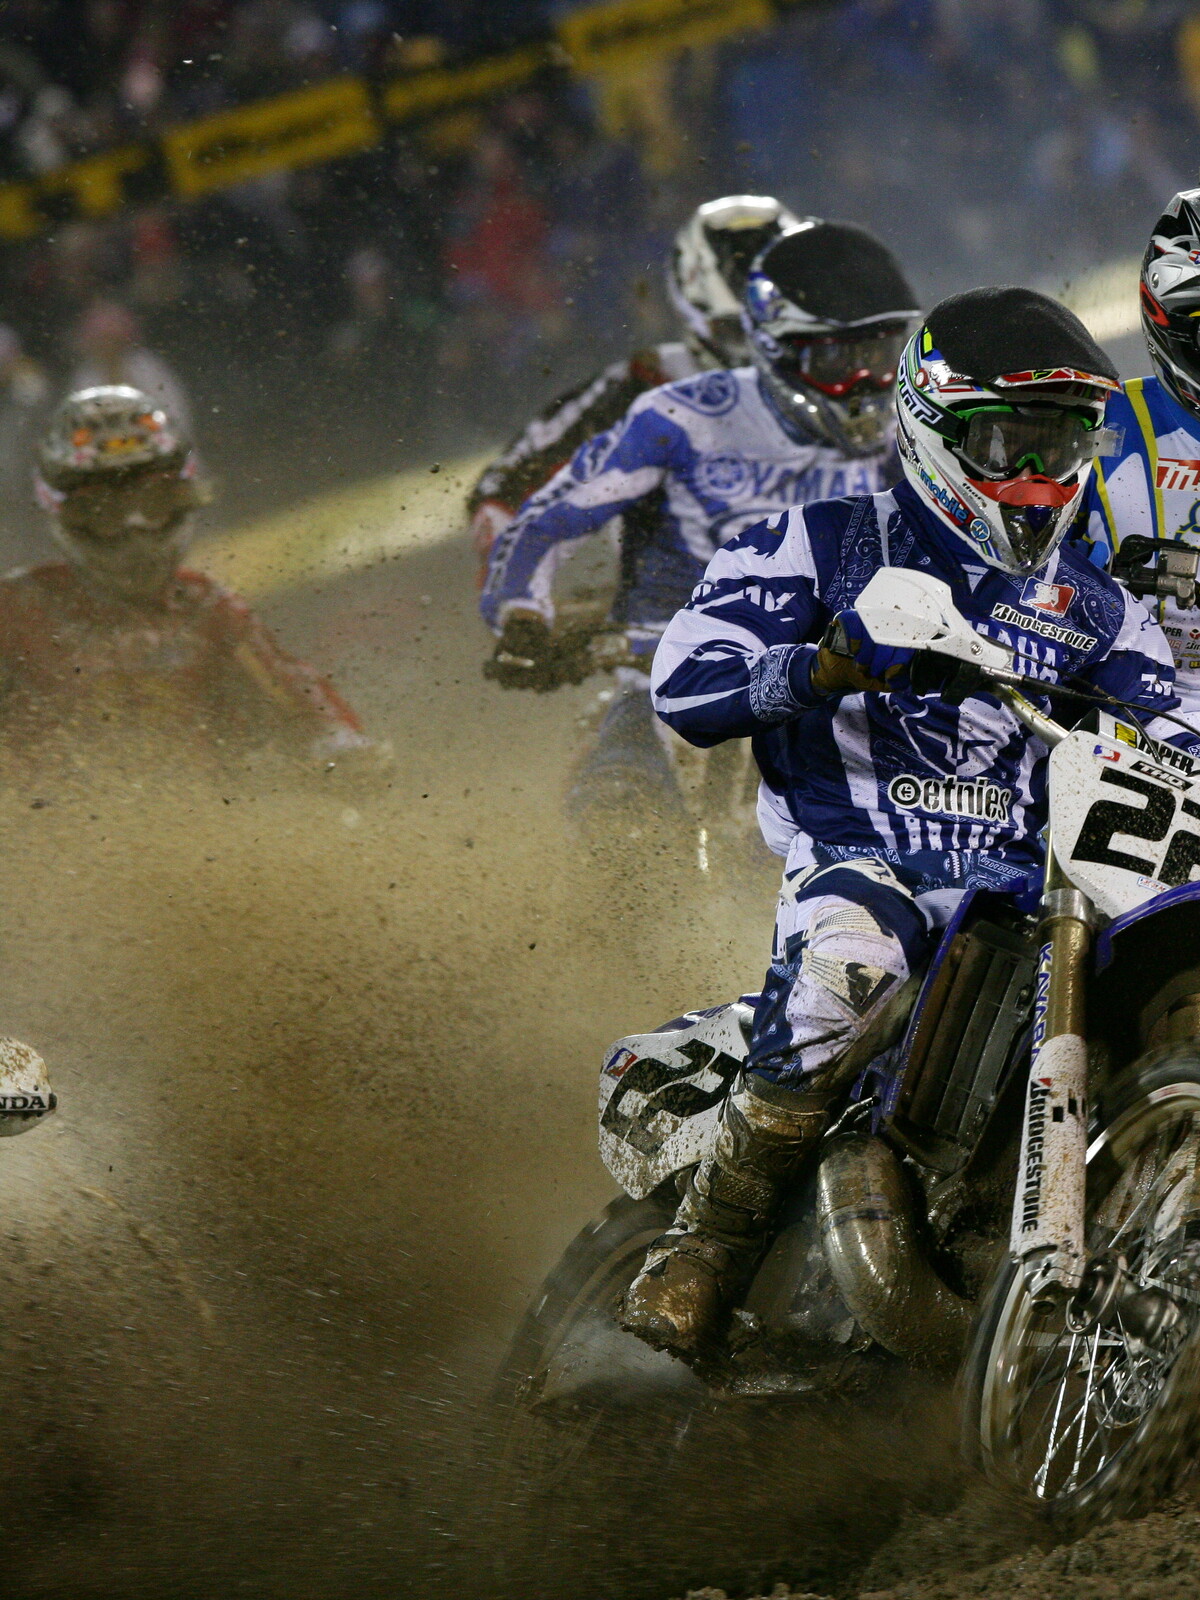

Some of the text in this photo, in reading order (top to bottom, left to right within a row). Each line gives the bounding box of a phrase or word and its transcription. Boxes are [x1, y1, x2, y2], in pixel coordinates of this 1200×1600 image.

[992, 604, 1097, 651] BRIDGESTONE
[1161, 625, 1183, 638] APER
[922, 776, 1012, 822] etnies
[1138, 762, 1187, 790] THQ
[601, 1038, 744, 1157] 22
[1021, 1078, 1052, 1235] BRIDGESTONE
